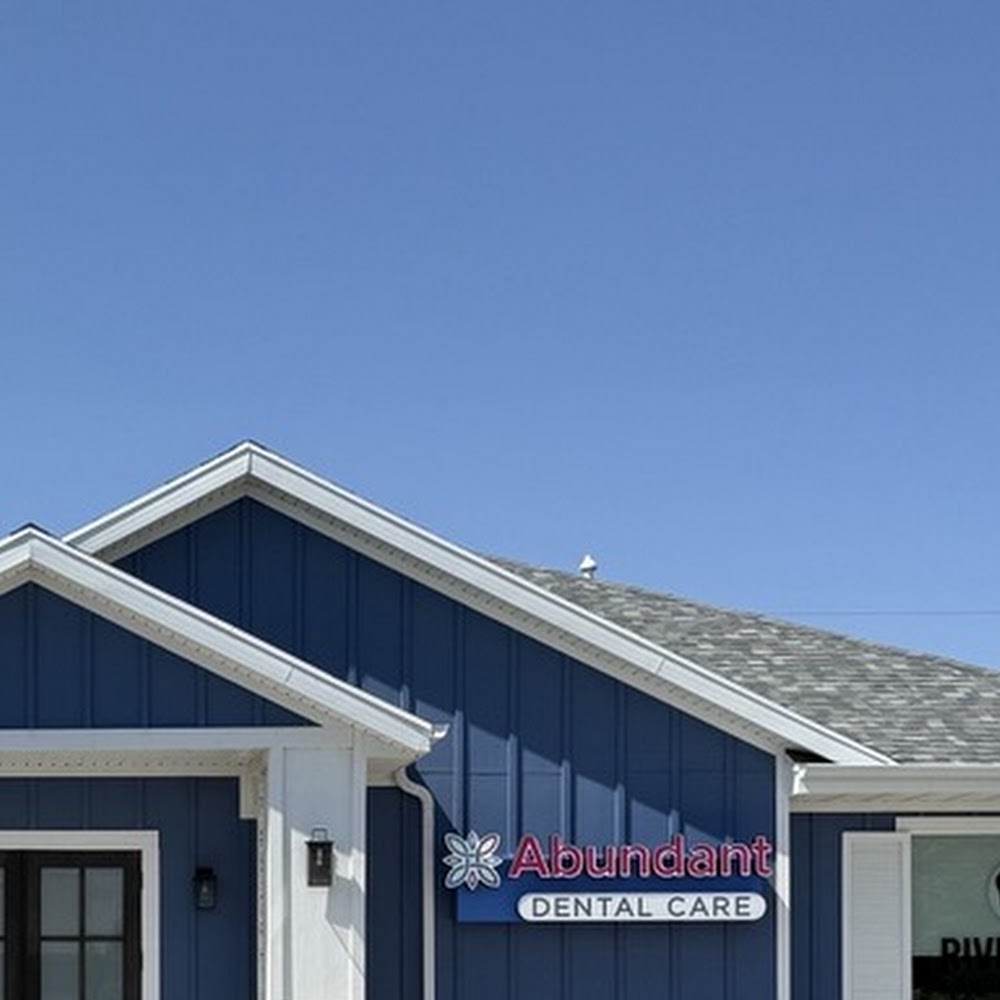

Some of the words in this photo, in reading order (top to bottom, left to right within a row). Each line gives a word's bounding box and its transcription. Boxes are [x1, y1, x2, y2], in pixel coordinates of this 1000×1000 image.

[509, 835, 773, 879] Abundant
[531, 897, 652, 918] DENTAL
[668, 897, 752, 918] CARE
[941, 937, 1000, 966] RIV
